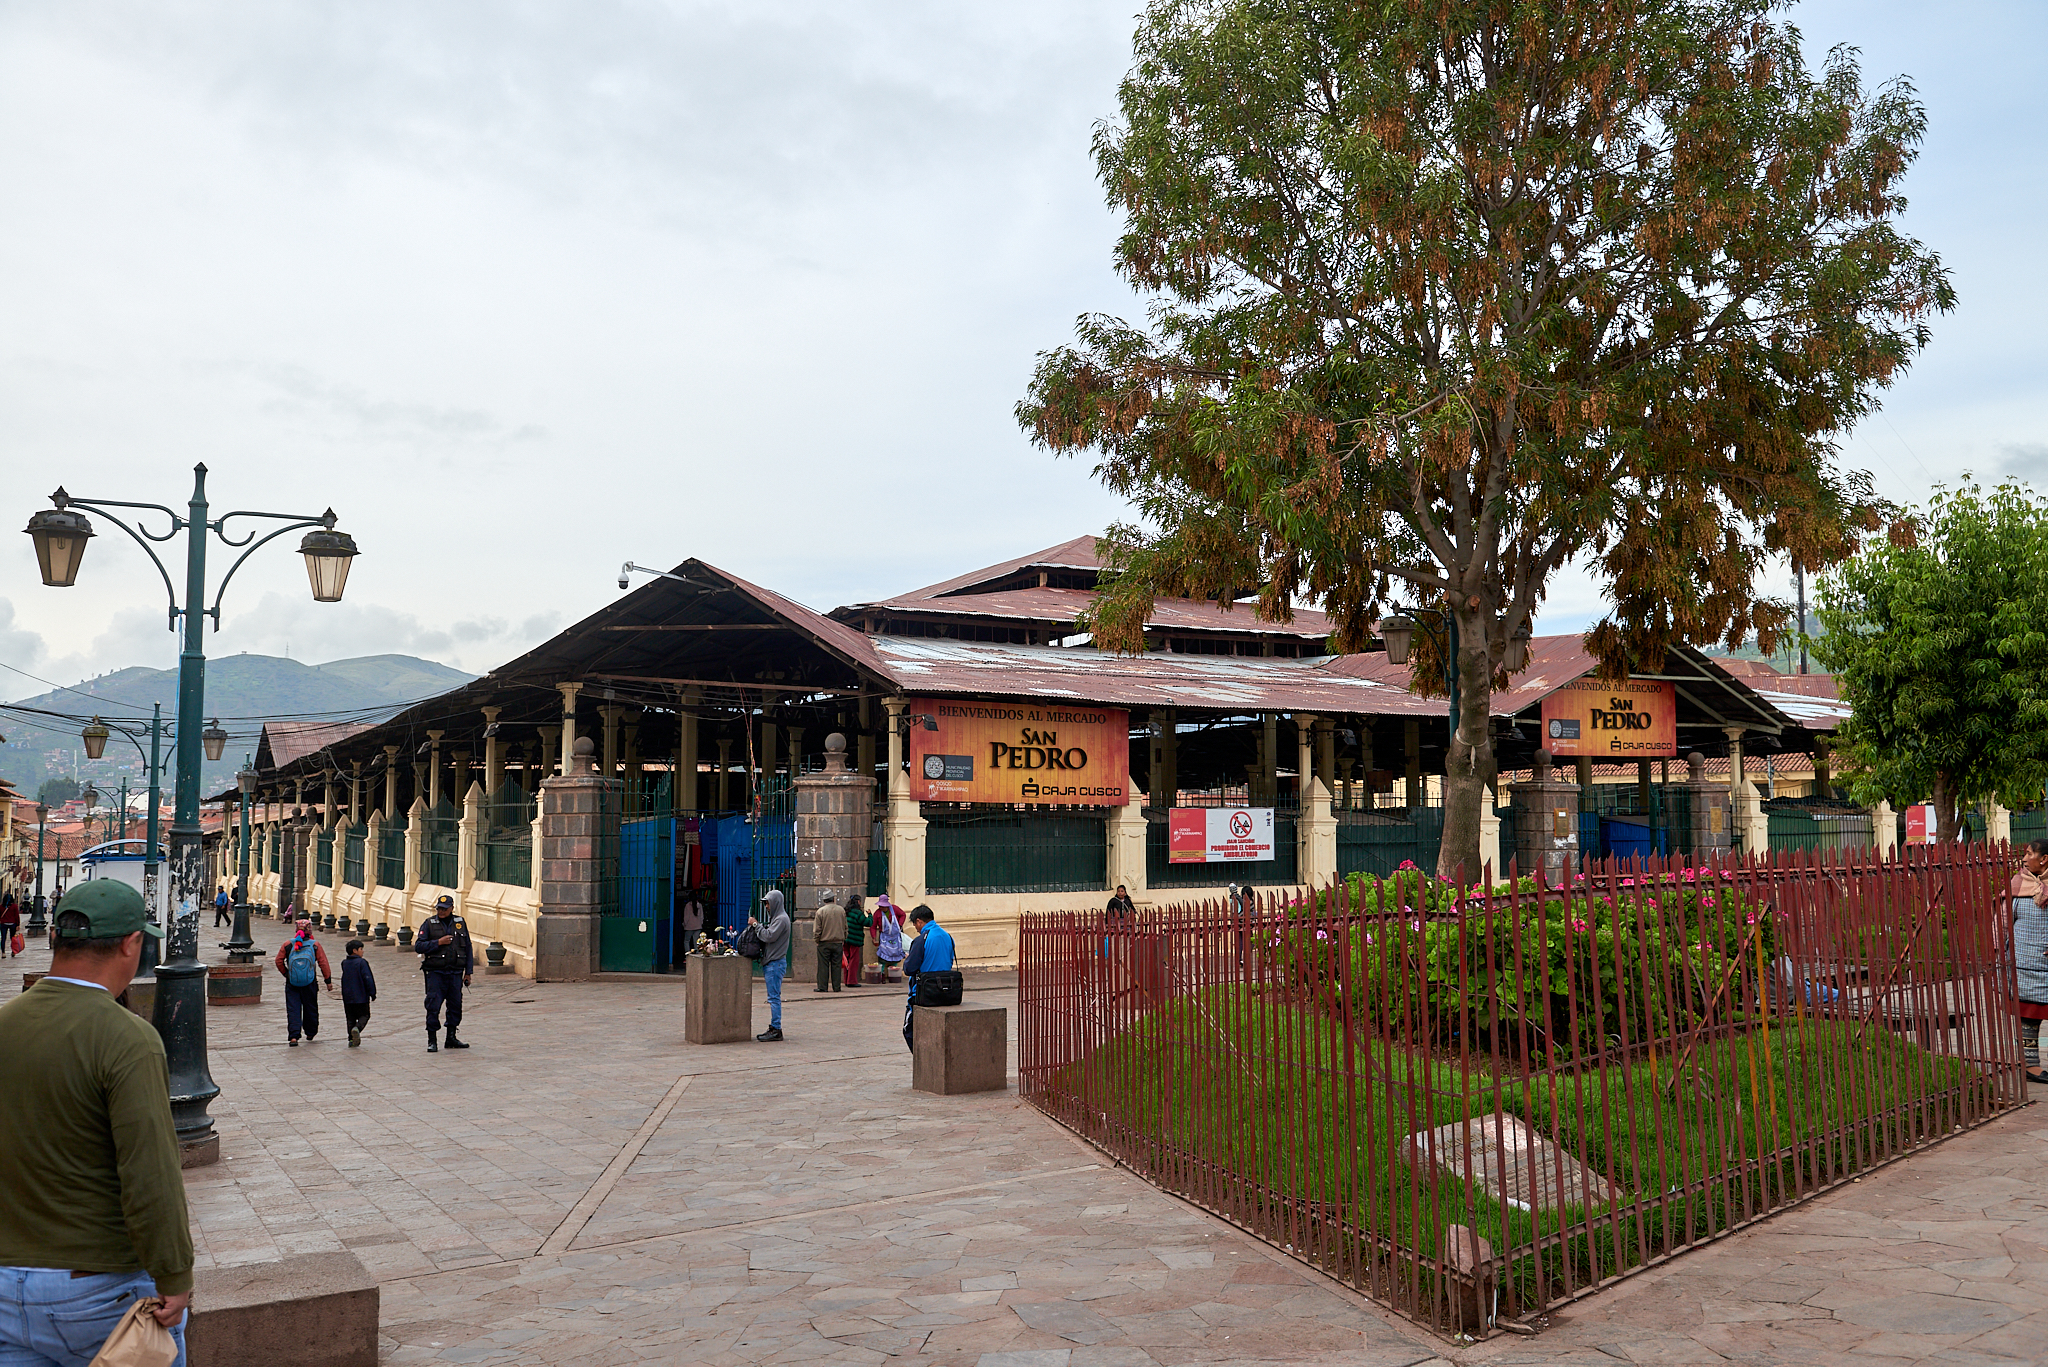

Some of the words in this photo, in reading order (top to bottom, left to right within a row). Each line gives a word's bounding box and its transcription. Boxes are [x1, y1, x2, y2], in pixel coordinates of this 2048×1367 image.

[1563, 682, 1611, 691] ENVENIDOS
[1613, 683, 1623, 692] AL
[1625, 684, 1662, 693] MERCADO
[1610, 697, 1633, 711] SAN
[938, 705, 1024, 720] BIENVENIDOS
[1027, 710, 1043, 721] AL
[1046, 711, 1107, 724] MERCADO
[1590, 708, 1652, 730] PEDRO
[1021, 727, 1057, 745] SAN
[1623, 742, 1644, 750] CAJA
[1646, 742, 1672, 750] CUSCO
[989, 741, 1088, 769] PEDRO
[1042, 786, 1077, 796] CAJA
[1079, 787, 1122, 797] CUSCO
